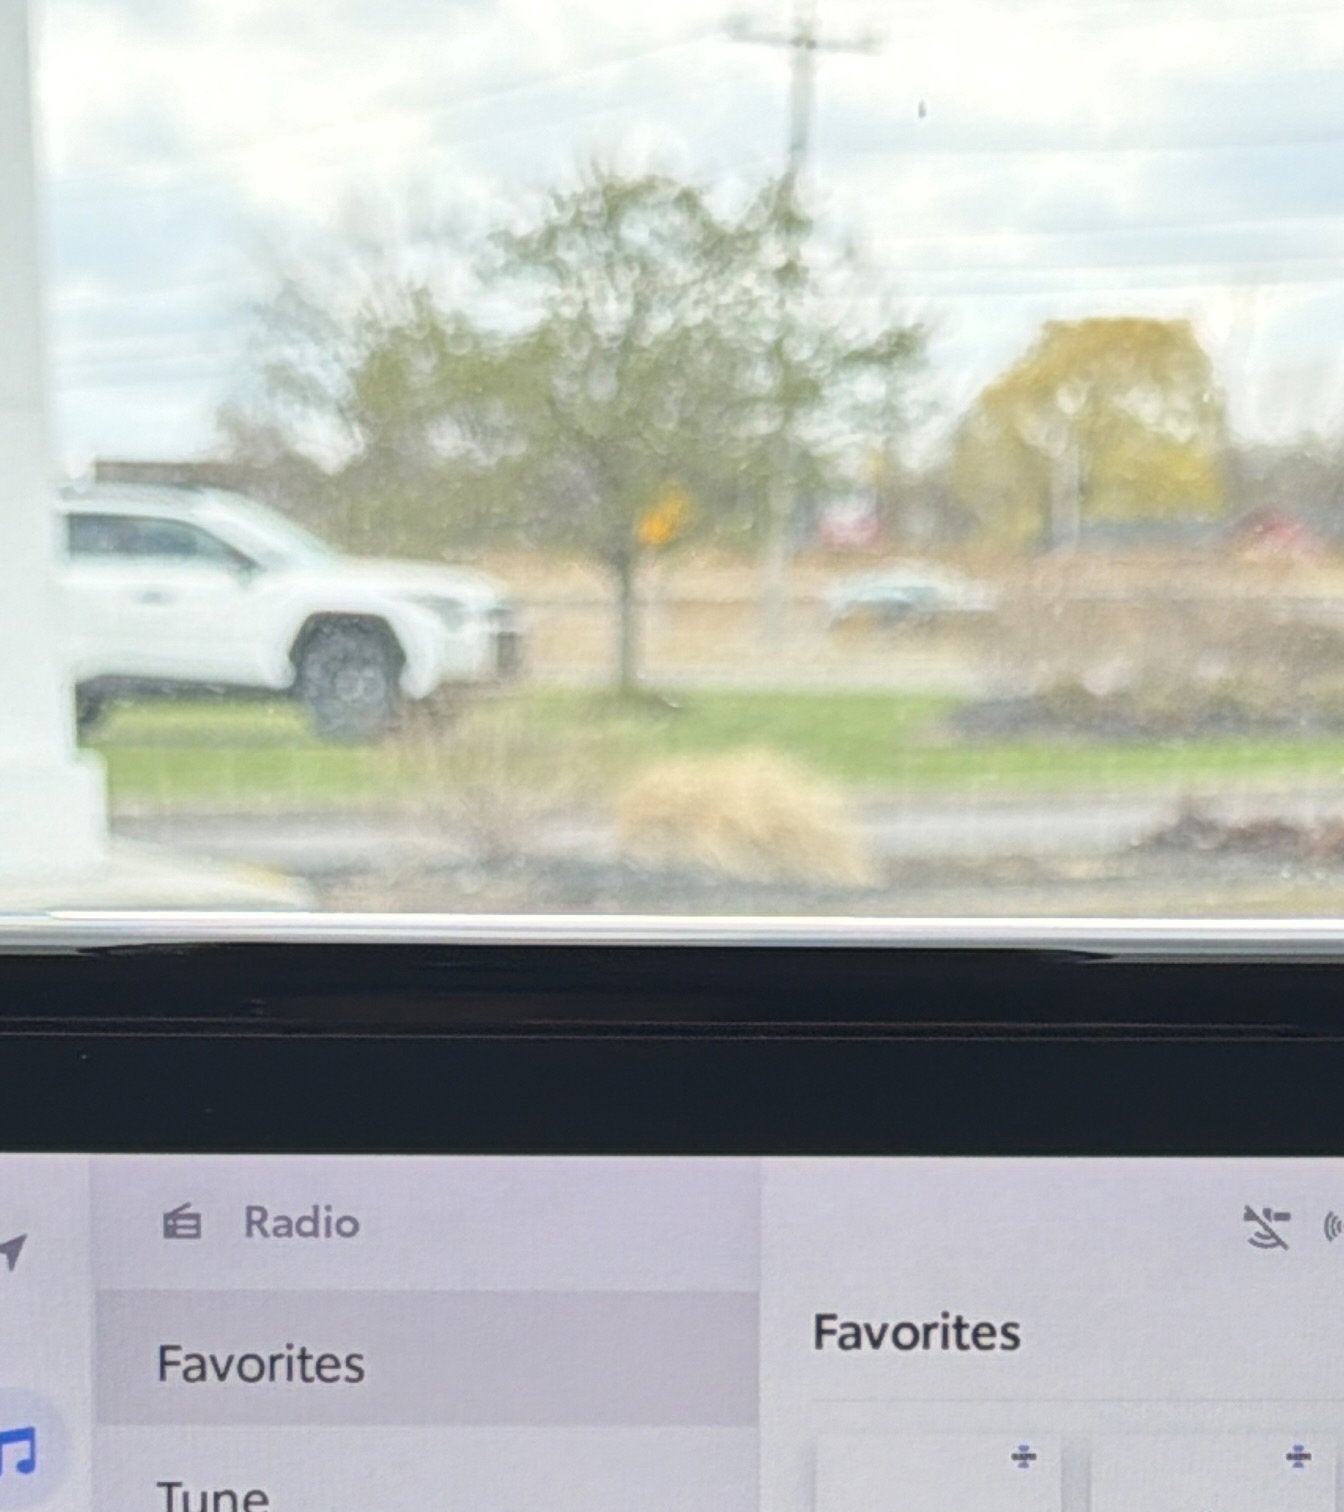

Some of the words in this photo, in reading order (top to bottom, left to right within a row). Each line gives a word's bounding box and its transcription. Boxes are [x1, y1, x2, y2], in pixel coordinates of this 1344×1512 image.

[245, 1204, 360, 1239] Radio
[814, 1311, 1021, 1351] Favorites
[159, 1342, 365, 1384] Favorites
